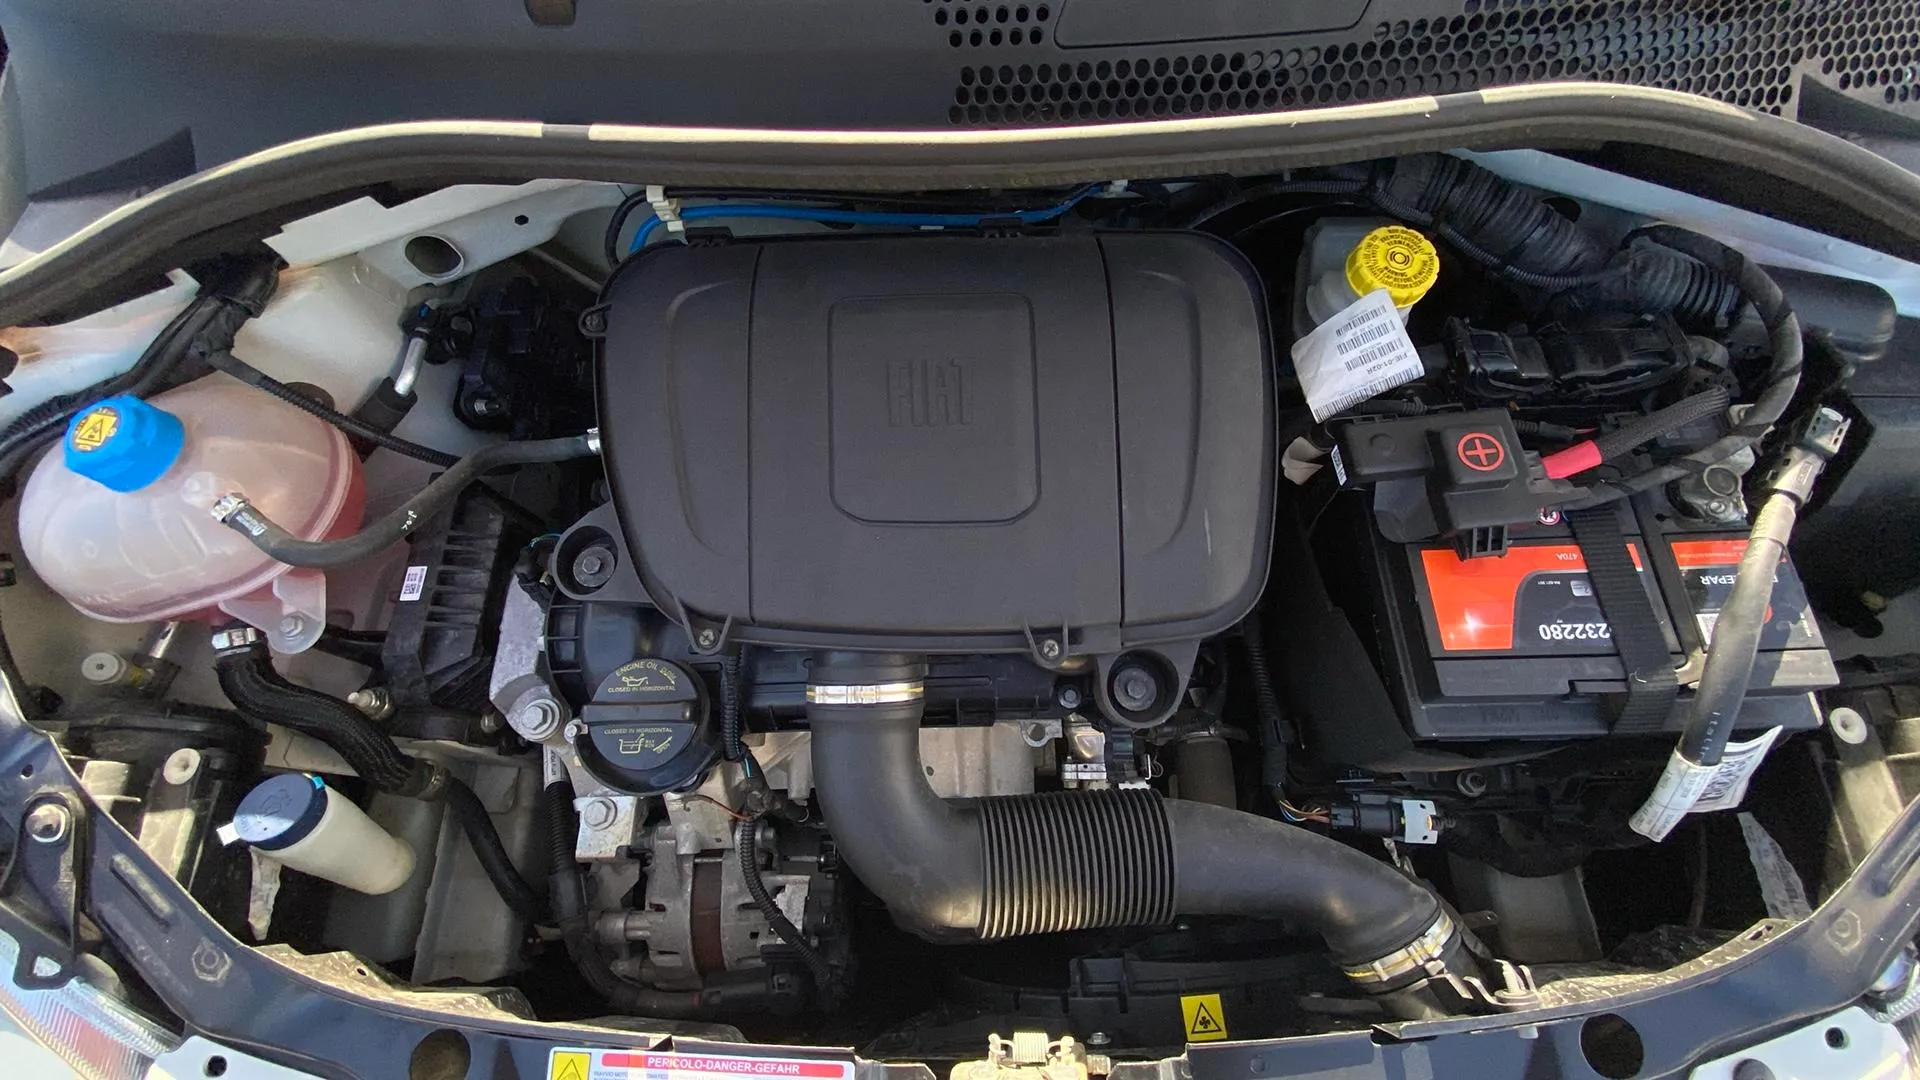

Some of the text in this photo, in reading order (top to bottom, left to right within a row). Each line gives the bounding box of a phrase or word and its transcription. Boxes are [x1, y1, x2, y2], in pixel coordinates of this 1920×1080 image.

[887, 358, 976, 427] FIAT
[1555, 552, 1578, 561] 470A
[1538, 622, 1612, 641] 232280
[615, 660, 658, 677] ENGINE OIL
[647, 1057, 800, 1074] PERICOLO-DANGER-GEFAHR
